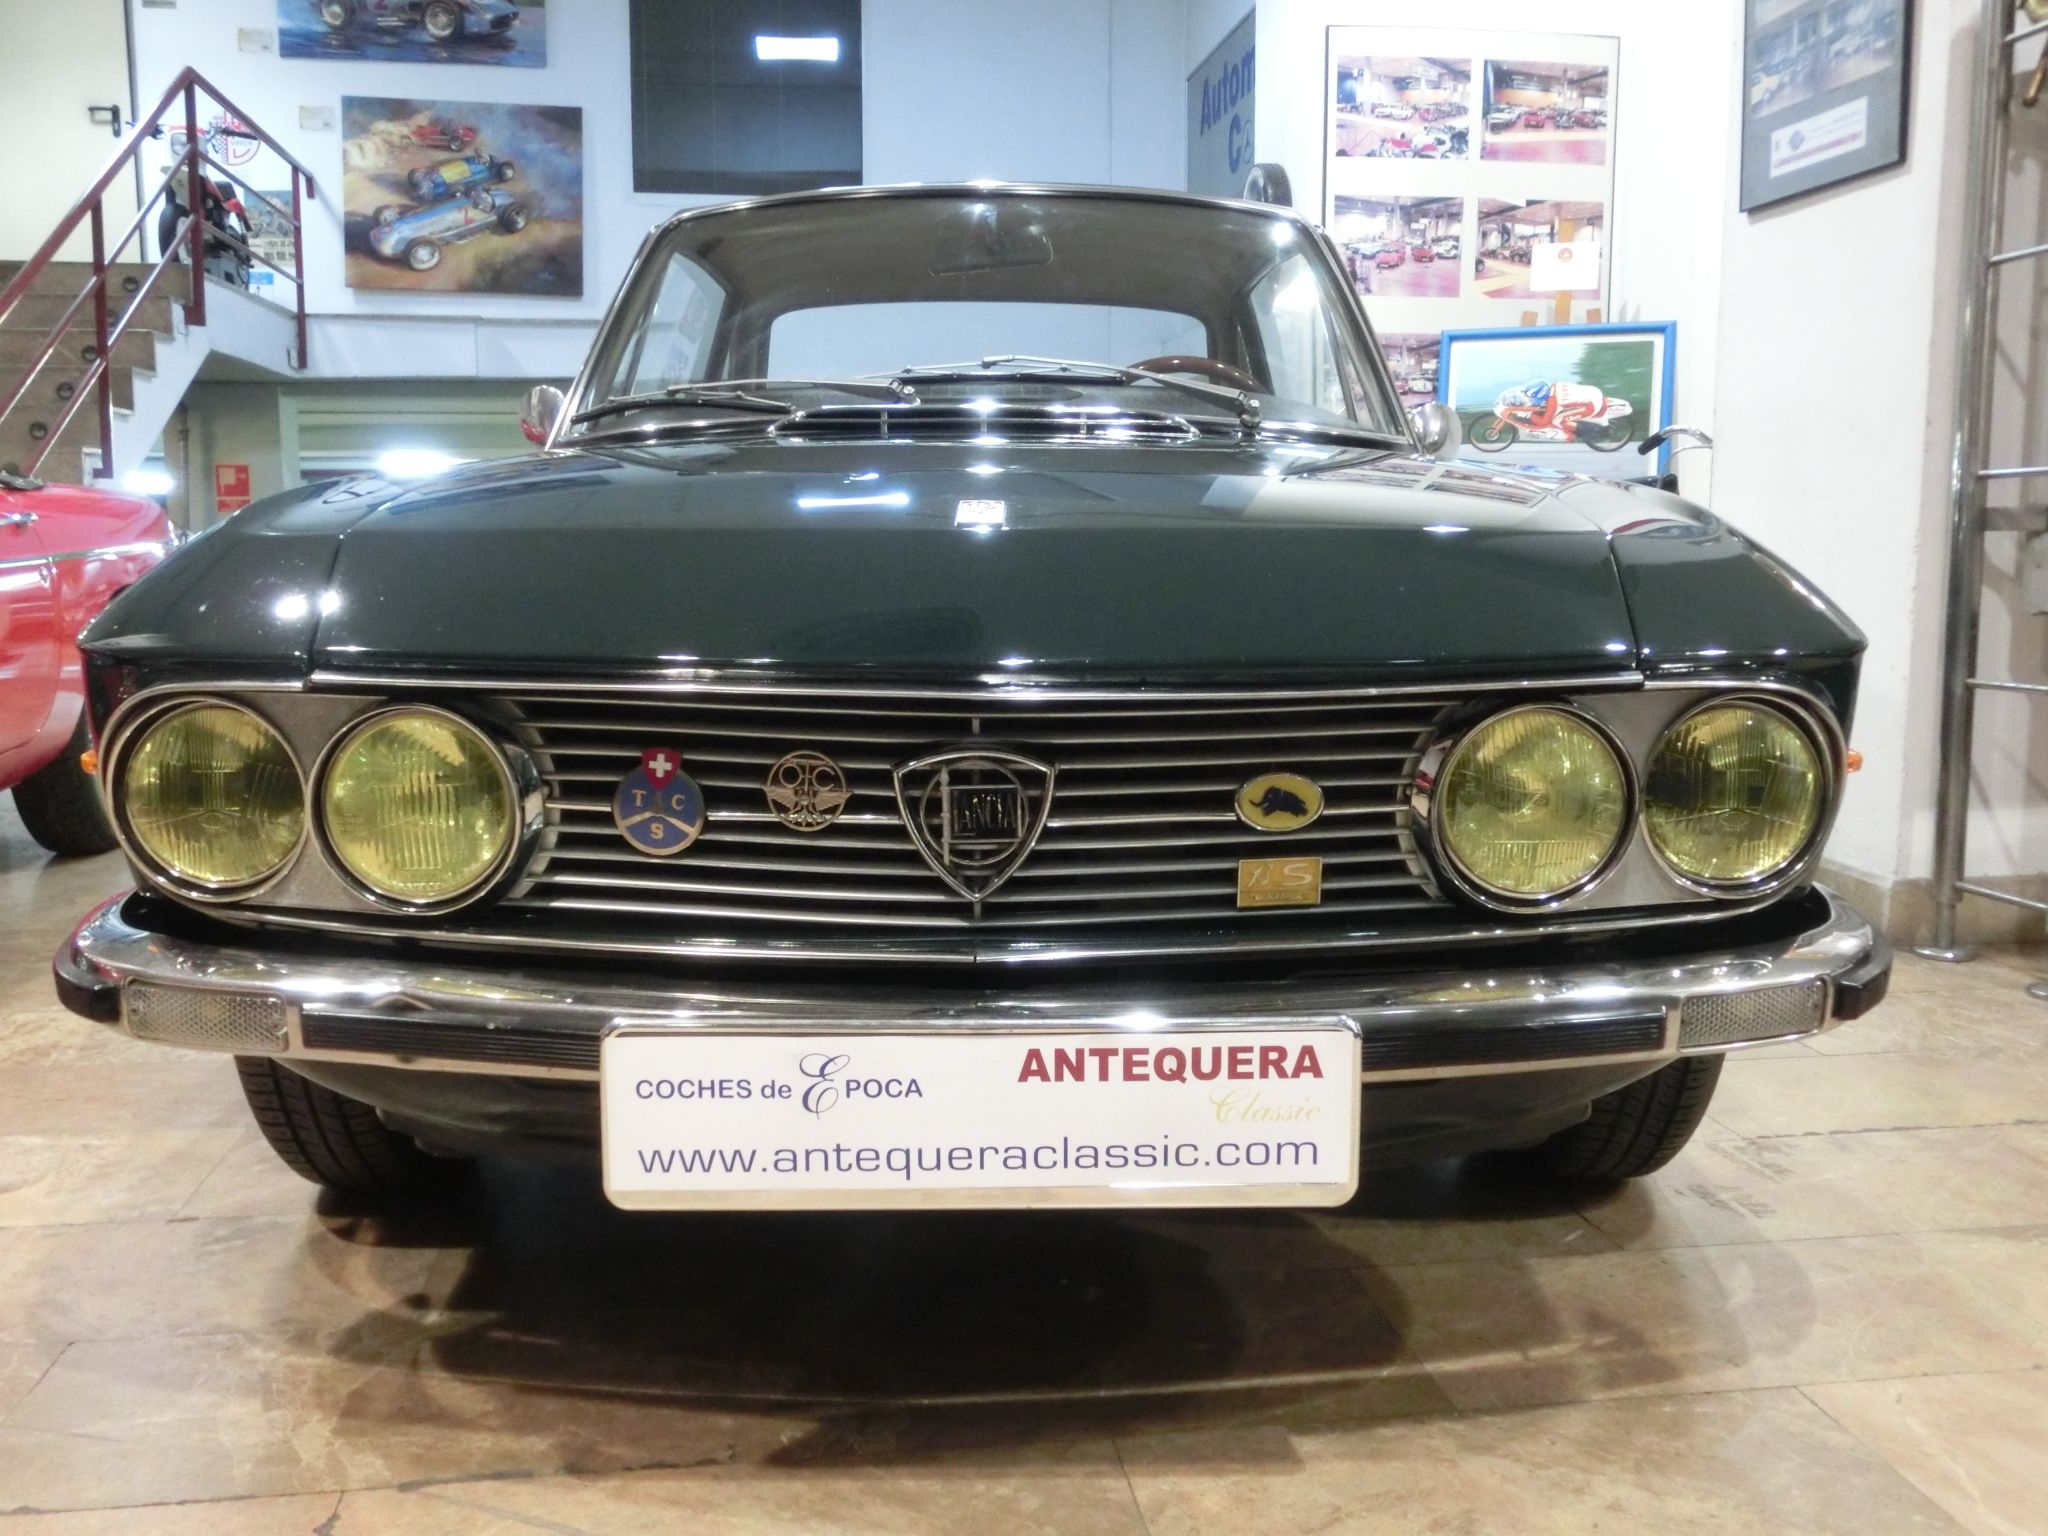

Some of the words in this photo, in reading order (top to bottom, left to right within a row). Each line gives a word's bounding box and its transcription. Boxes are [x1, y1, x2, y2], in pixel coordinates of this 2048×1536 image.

[953, 791, 1017, 836] LANCIA
[1017, 1045, 1324, 1084] ANTEQUERA
[636, 1079, 752, 1099] COCHES
[760, 1079, 792, 1099] de
[1208, 1087, 1321, 1124] Classic
[637, 1134, 1319, 1181] www.antequeraclassic.com
